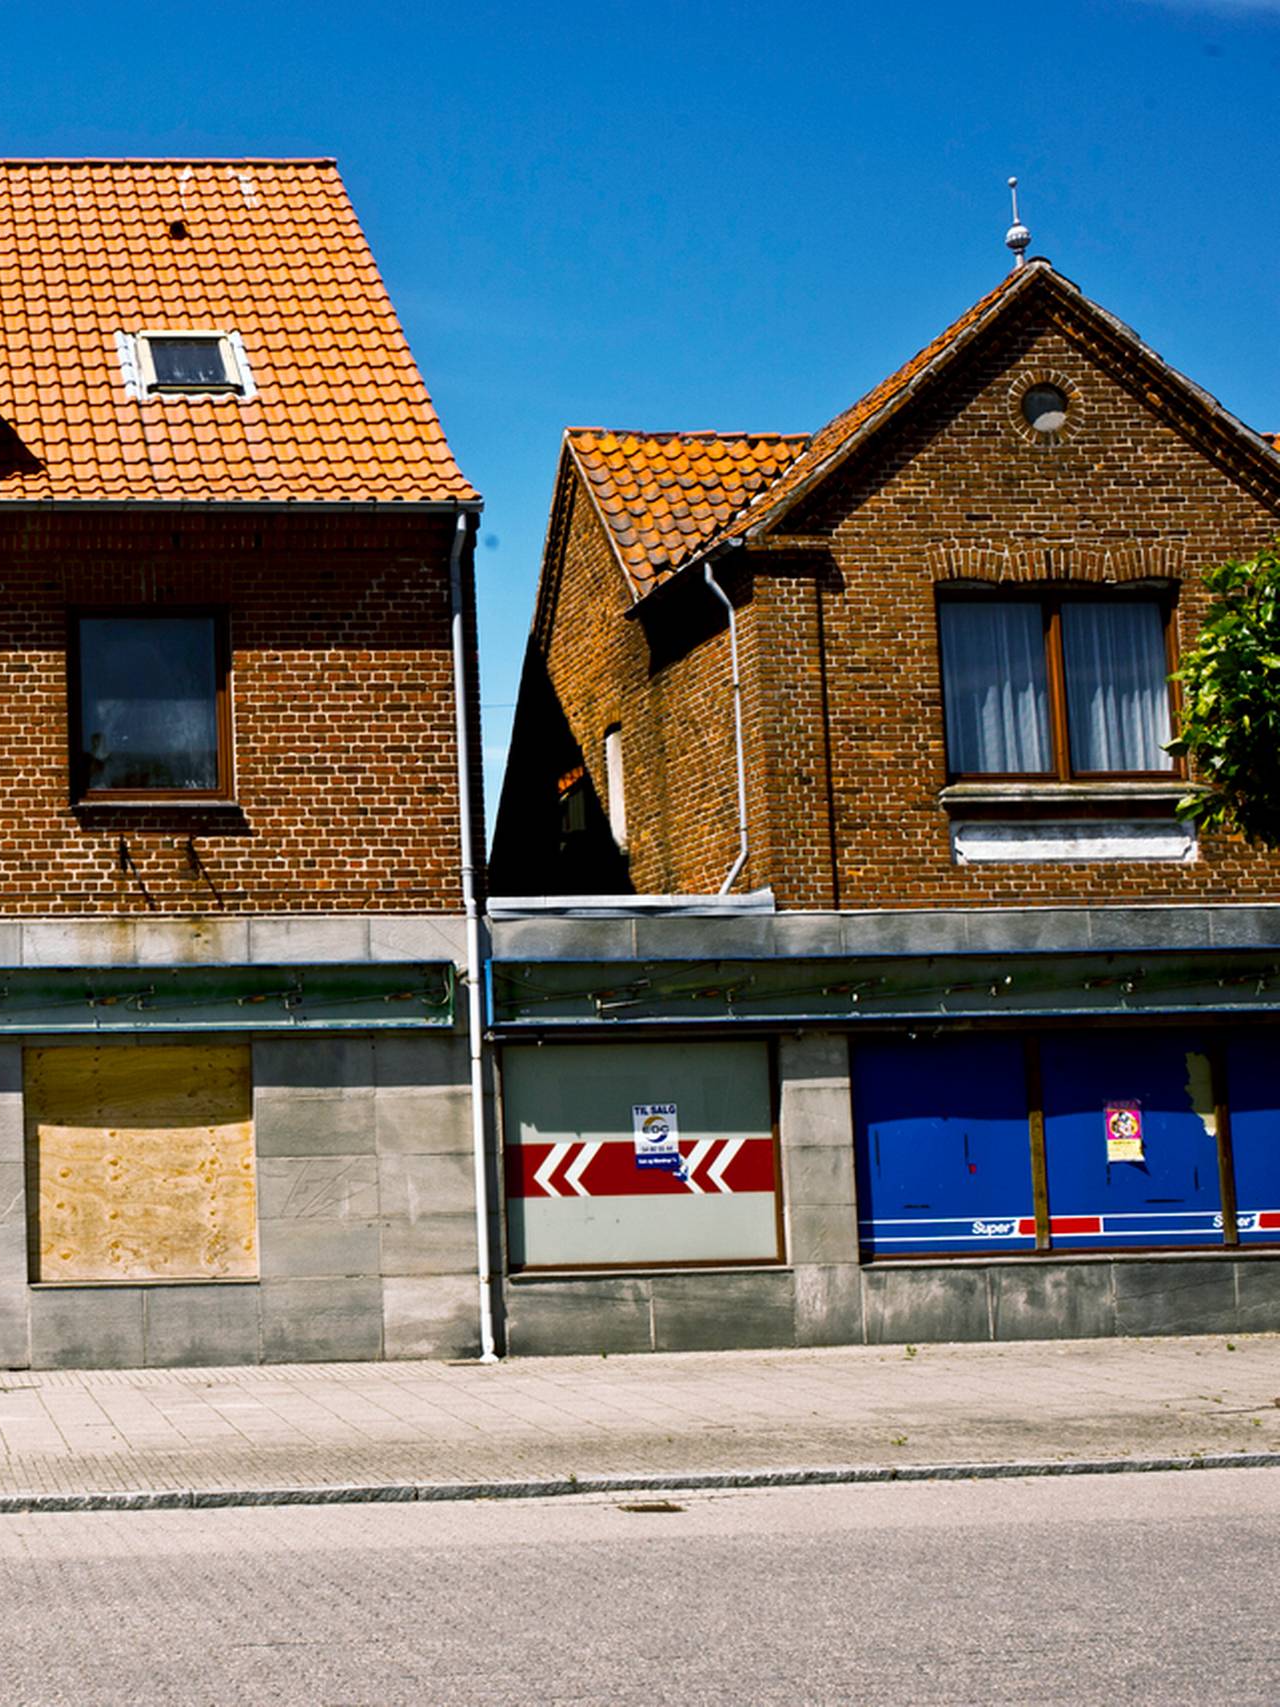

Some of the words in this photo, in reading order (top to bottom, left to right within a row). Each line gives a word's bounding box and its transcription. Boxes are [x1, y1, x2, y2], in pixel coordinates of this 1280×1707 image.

[635, 1106, 648, 1115] TIL
[651, 1104, 675, 1114] SALG
[1213, 1214, 1251, 1229] Ser
